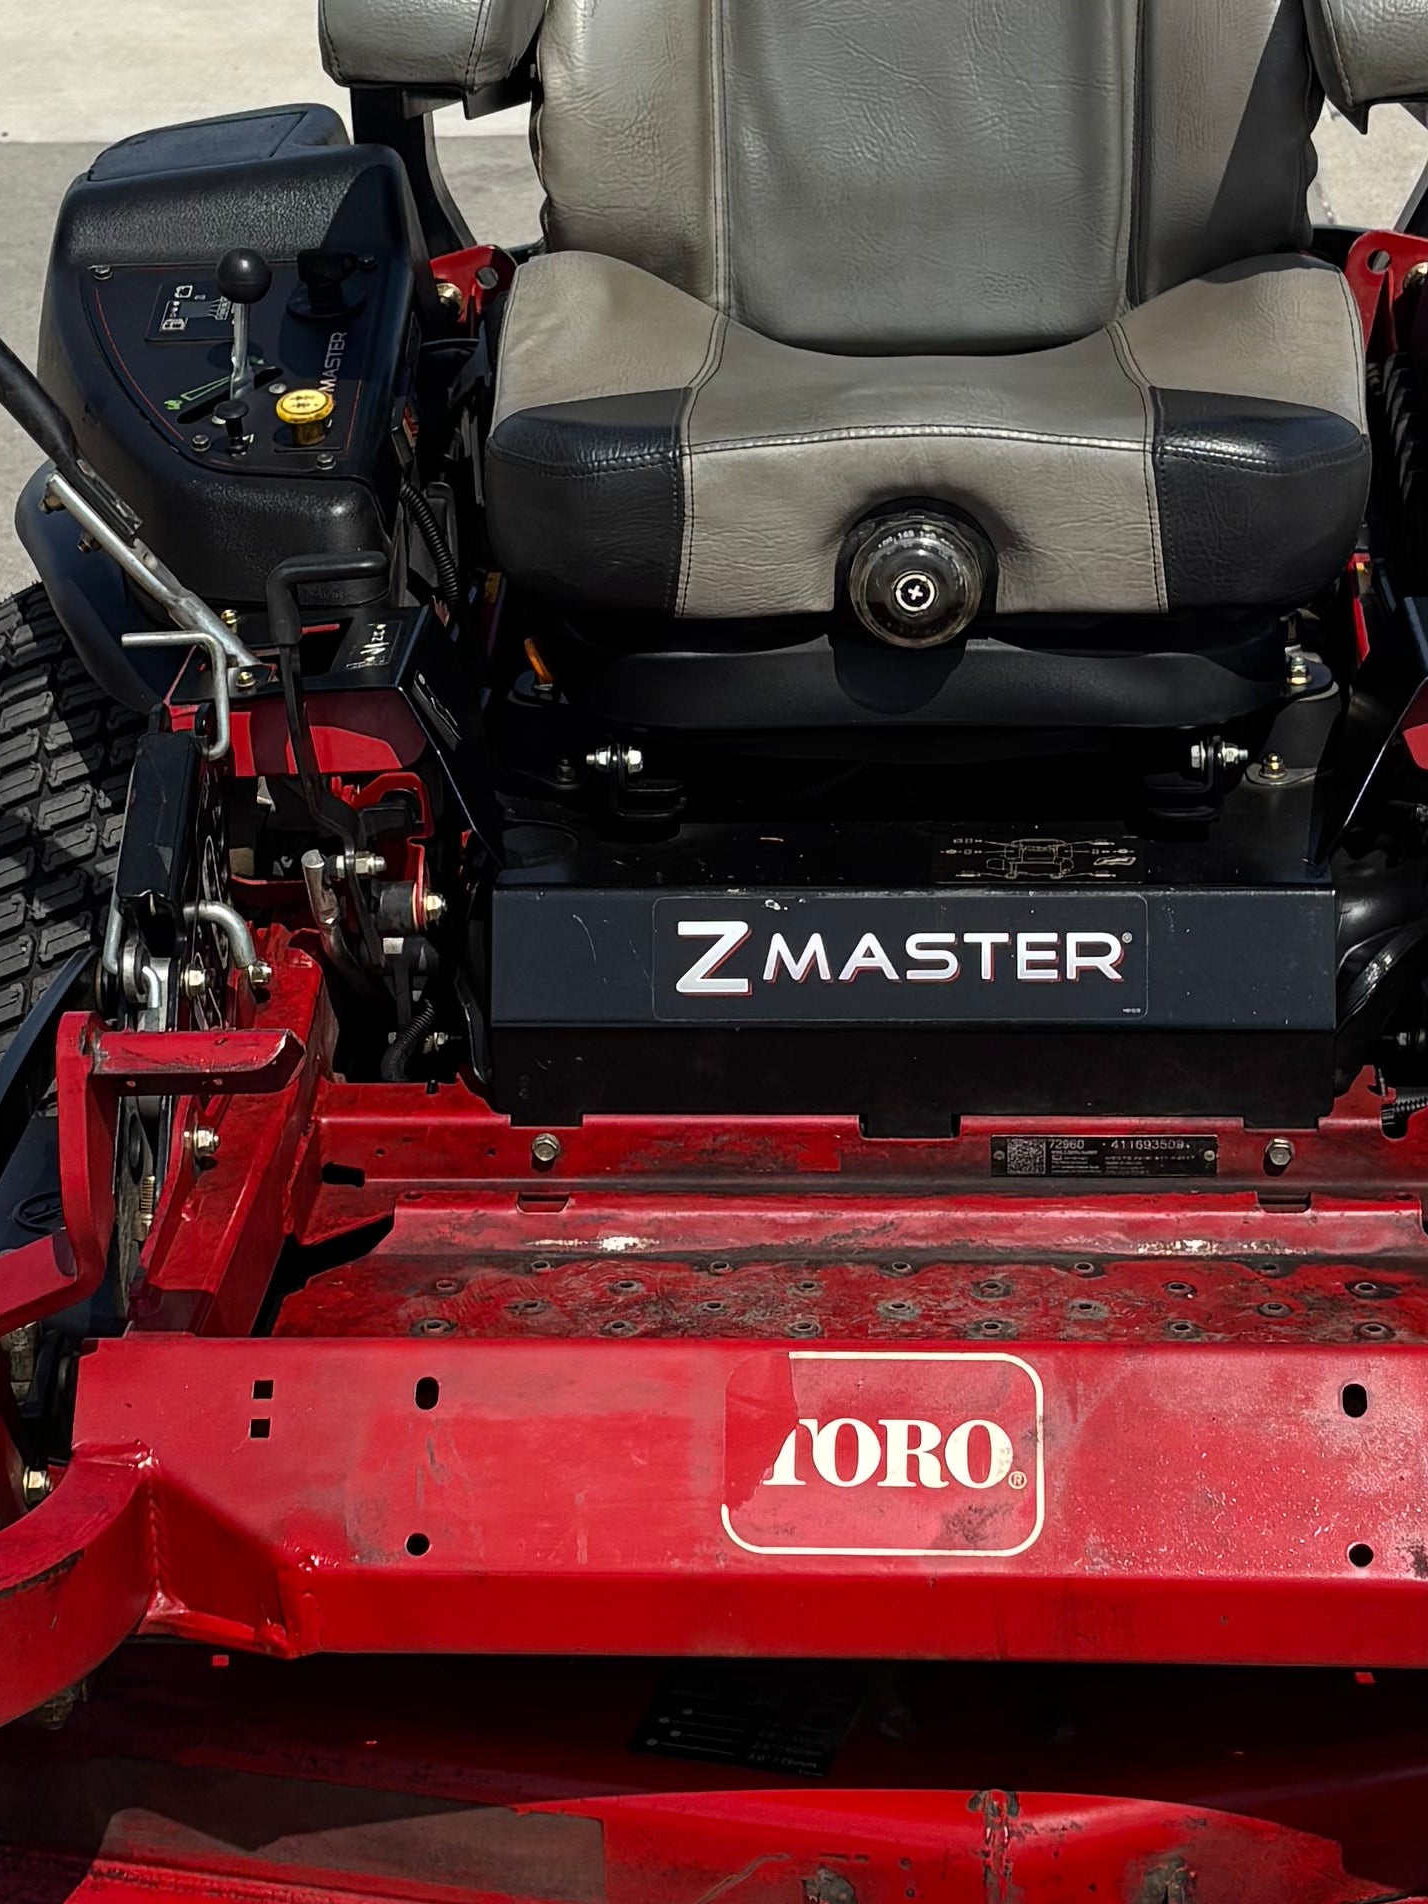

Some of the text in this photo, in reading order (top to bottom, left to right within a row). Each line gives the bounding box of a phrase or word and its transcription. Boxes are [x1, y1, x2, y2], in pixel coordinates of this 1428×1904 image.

[317, 331, 348, 392] MASTER
[675, 920, 1126, 995] Z MASTER
[762, 1417, 1014, 1489] TORO
